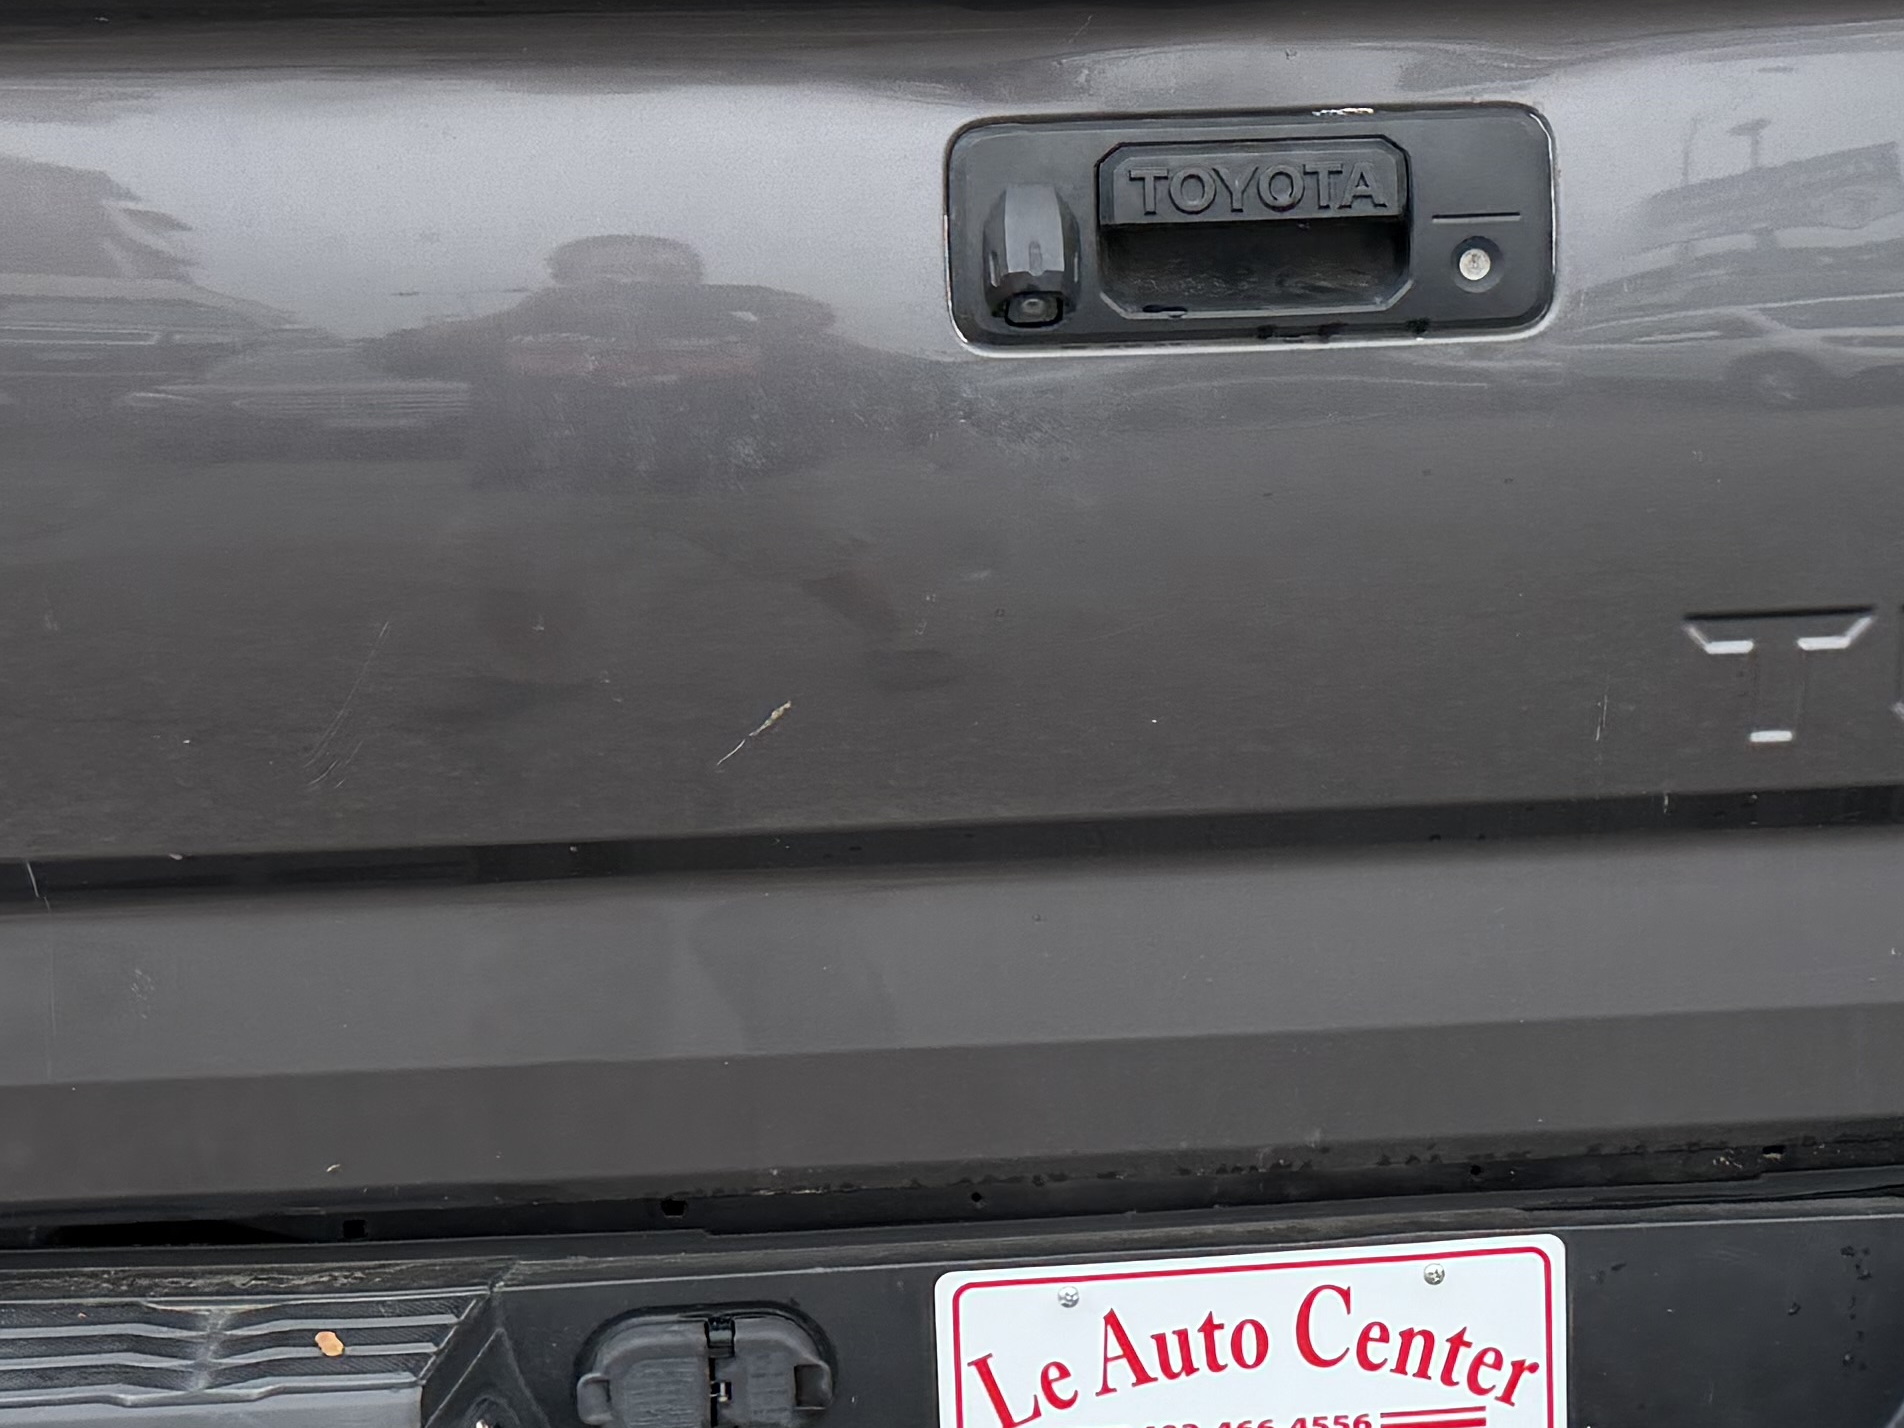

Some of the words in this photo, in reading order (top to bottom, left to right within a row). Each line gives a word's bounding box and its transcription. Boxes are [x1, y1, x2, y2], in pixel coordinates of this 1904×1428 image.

[1129, 162, 1388, 216] TOYOTA
[1094, 1306, 1270, 1398] Auto
[1294, 1283, 1540, 1408] Center
